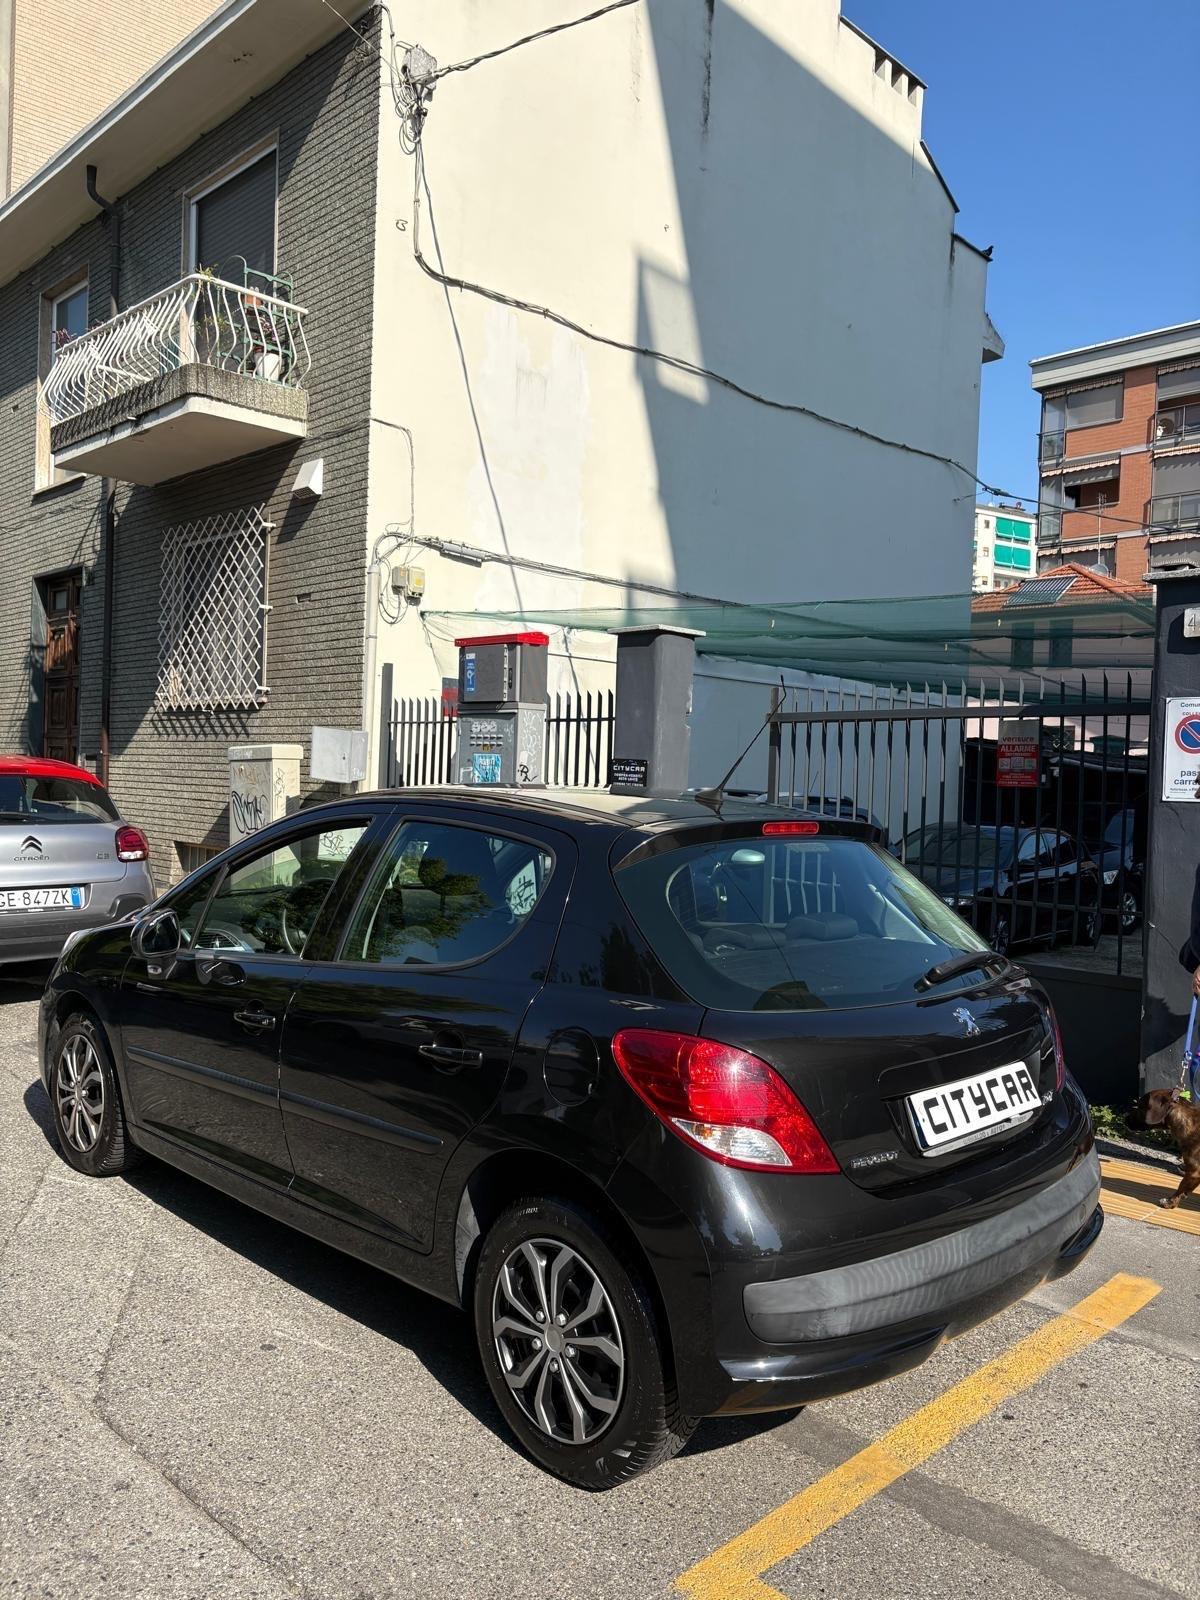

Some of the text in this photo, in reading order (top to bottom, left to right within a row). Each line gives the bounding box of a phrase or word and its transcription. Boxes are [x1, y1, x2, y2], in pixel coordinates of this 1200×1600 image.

[1000, 745, 1036, 753] ALLARME
[1180, 770, 1197, 778] pas
[923, 1069, 1037, 1135] CITYCAR
[850, 1151, 898, 1168] PEUGEOT
